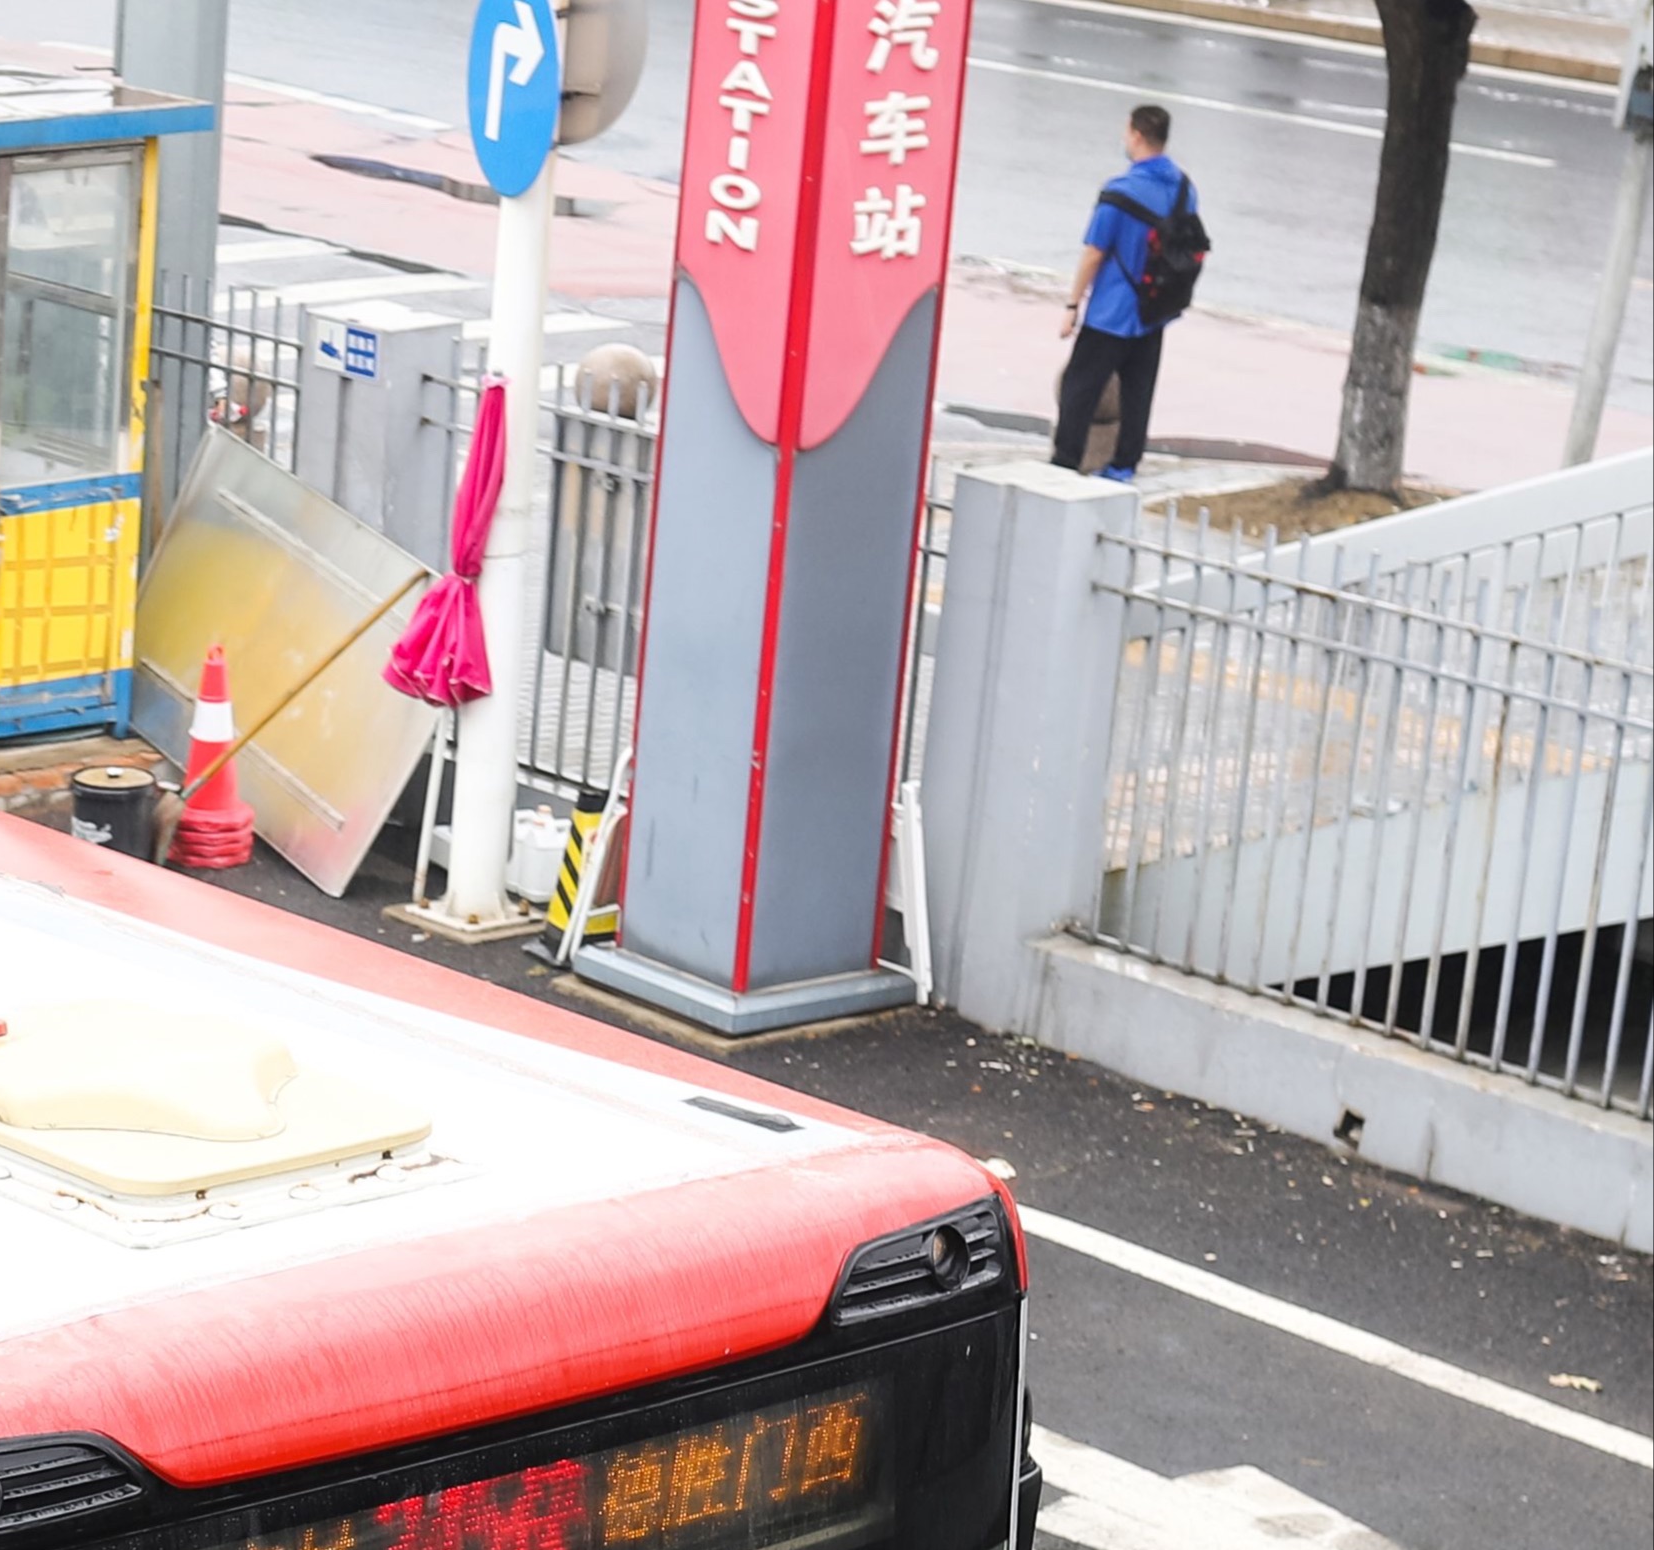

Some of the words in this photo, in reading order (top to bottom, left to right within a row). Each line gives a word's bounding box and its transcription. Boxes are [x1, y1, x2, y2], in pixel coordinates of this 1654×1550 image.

[850, 0, 942, 259] 汽车站
[599, 1392, 866, 1545] 德胜门西
